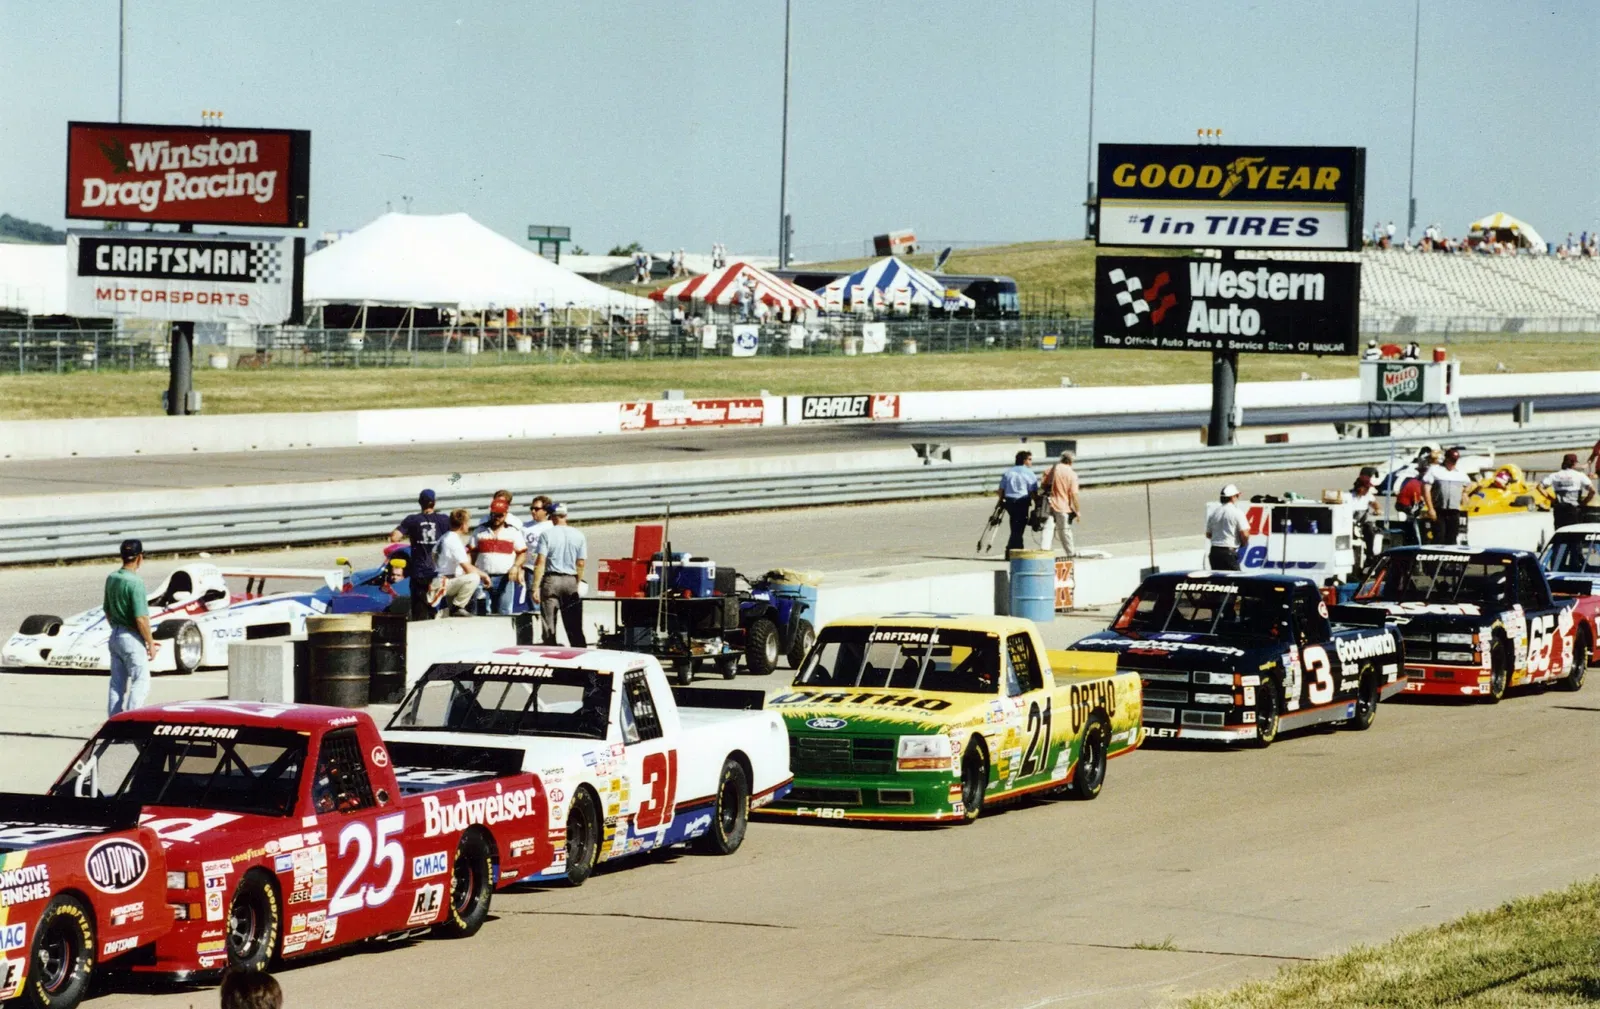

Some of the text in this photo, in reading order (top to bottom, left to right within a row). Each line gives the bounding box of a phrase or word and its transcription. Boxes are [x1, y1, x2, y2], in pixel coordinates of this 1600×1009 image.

[130, 138, 258, 172] Winston
[81, 168, 277, 213] Drag Racing
[1160, 217, 1195, 234] in
[1205, 216, 1320, 237] TIRES
[95, 245, 247, 276] CRAFTSMAN
[1190, 262, 1325, 301] Western
[96, 288, 249, 306] MOTORSPORTS
[1187, 300, 1261, 336] Auto
[1103, 335, 1121, 345] The
[1161, 337, 1184, 347] Auto
[1187, 338, 1212, 348] Parts
[1215, 339, 1224, 348] &
[1228, 340, 1264, 350] Service
[1297, 341, 1310, 351] Of
[1415, 553, 1470, 562] CRAFTSMAN
[1175, 583, 1239, 594] CRAFTSMAN
[868, 632, 940, 643] CRAFTSMAN
[1528, 614, 1555, 674] 65
[473, 664, 554, 678] CRAFTSMAN
[1303, 645, 1335, 705] 3
[769, 691, 953, 711] ORTHO
[1070, 679, 1116, 734] ORTHO
[153, 724, 239, 740] CRAFTSMAN
[812, 718, 840, 728] Ford
[1017, 696, 1052, 780] 21
[635, 749, 678, 830] 31
[421, 782, 536, 838] Budweiser
[327, 811, 405, 917] 25
[414, 853, 447, 878] GMAC
[1, 881, 51, 907] FINISHES
[206, 876, 225, 889] JE
[289, 890, 312, 904] JESEL
